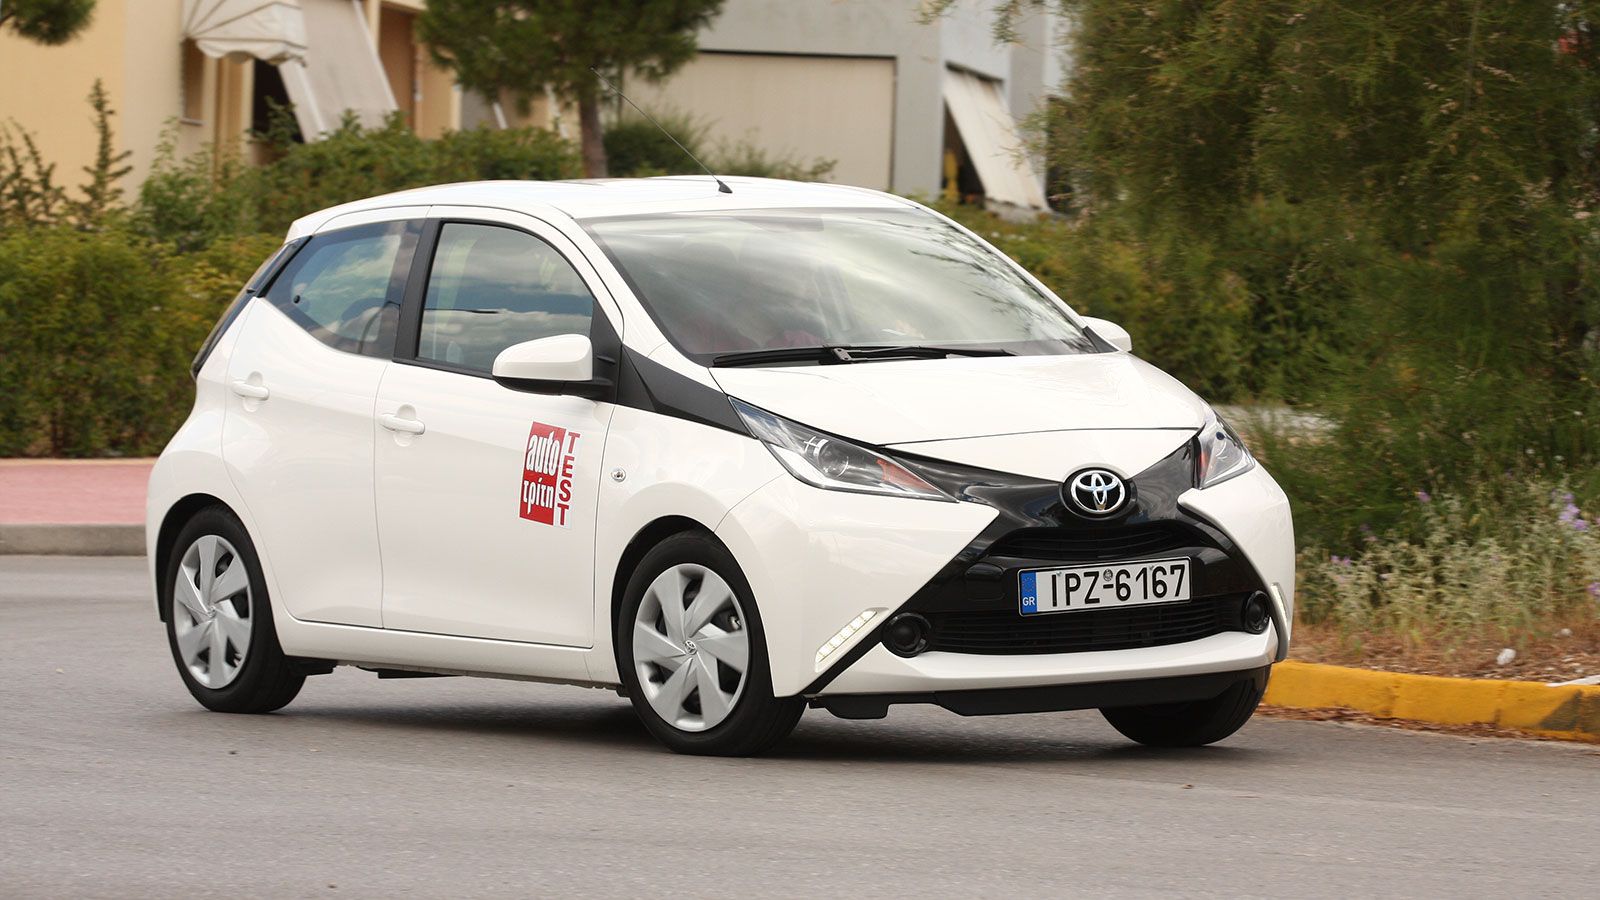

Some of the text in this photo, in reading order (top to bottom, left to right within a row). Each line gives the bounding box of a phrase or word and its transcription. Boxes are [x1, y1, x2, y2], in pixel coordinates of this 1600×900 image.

[525, 430, 561, 477] auto
[557, 431, 581, 526] TEST
[1022, 596, 1036, 607] GR
